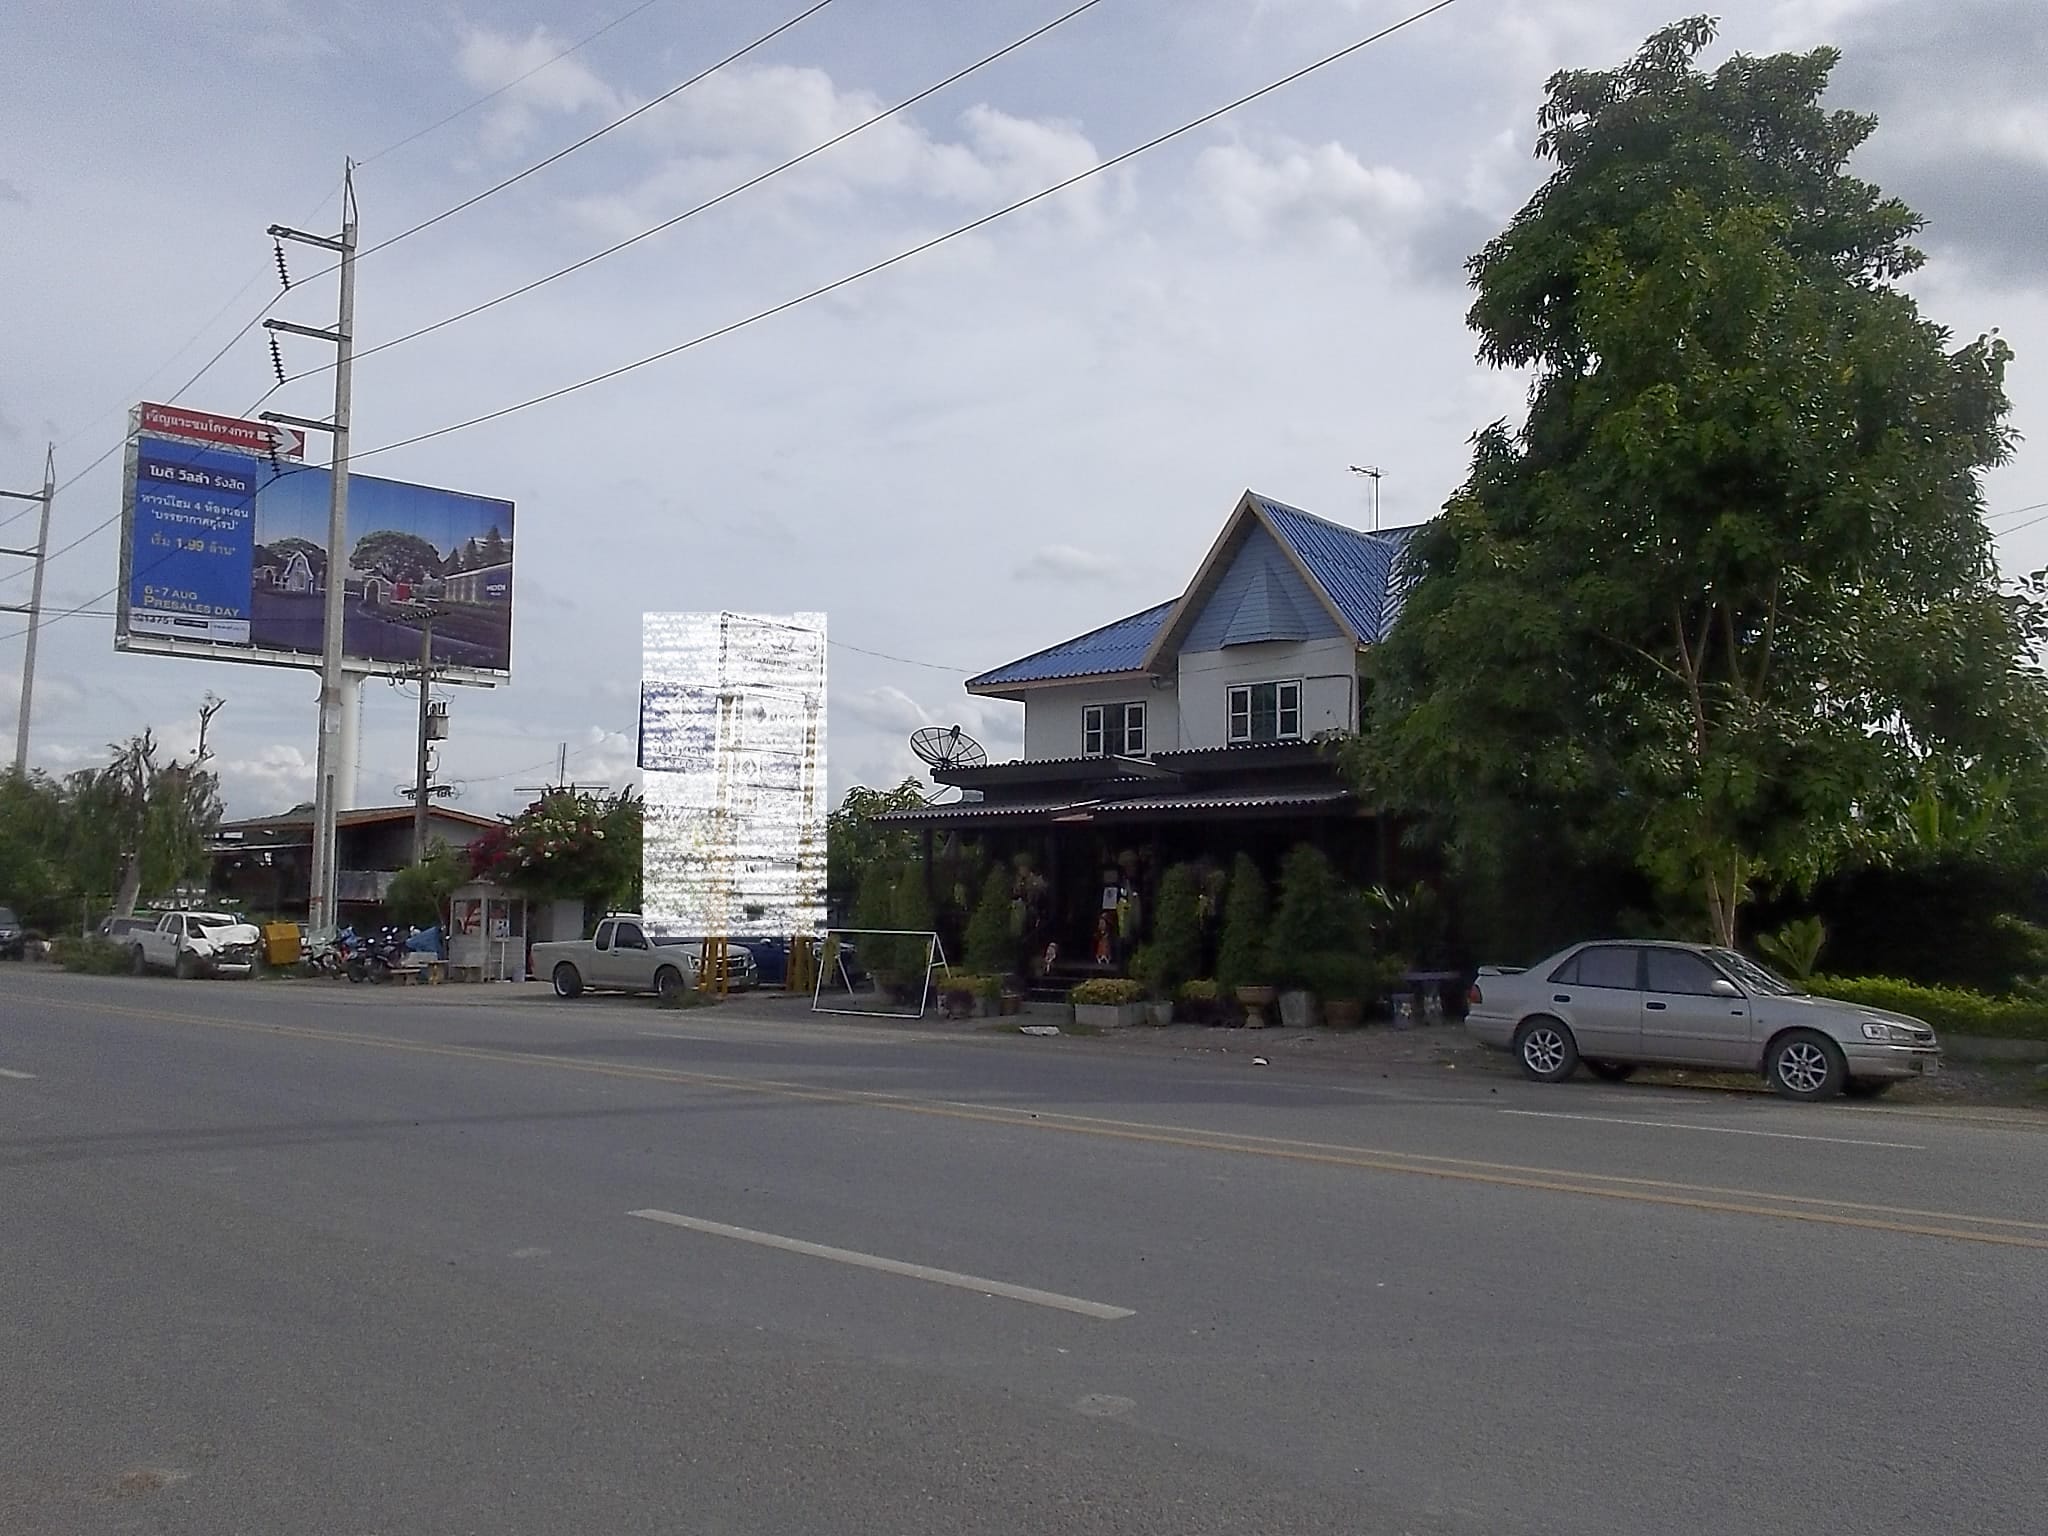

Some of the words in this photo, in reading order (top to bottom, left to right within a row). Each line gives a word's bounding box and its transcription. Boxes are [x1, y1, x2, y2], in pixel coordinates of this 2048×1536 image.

[145, 408, 255, 439] เชิญแวะชมโครงการ
[178, 469, 210, 485] วิลล่า
[214, 475, 246, 491] รังสิต
[141, 493, 191, 509] ทาวน์โฮม
[194, 502, 201, 511] 4
[204, 500, 249, 518] ห้องนอน
[176, 538, 205, 552] 1.99
[172, 589, 198, 600] AUG
[214, 606, 241, 617] DAY
